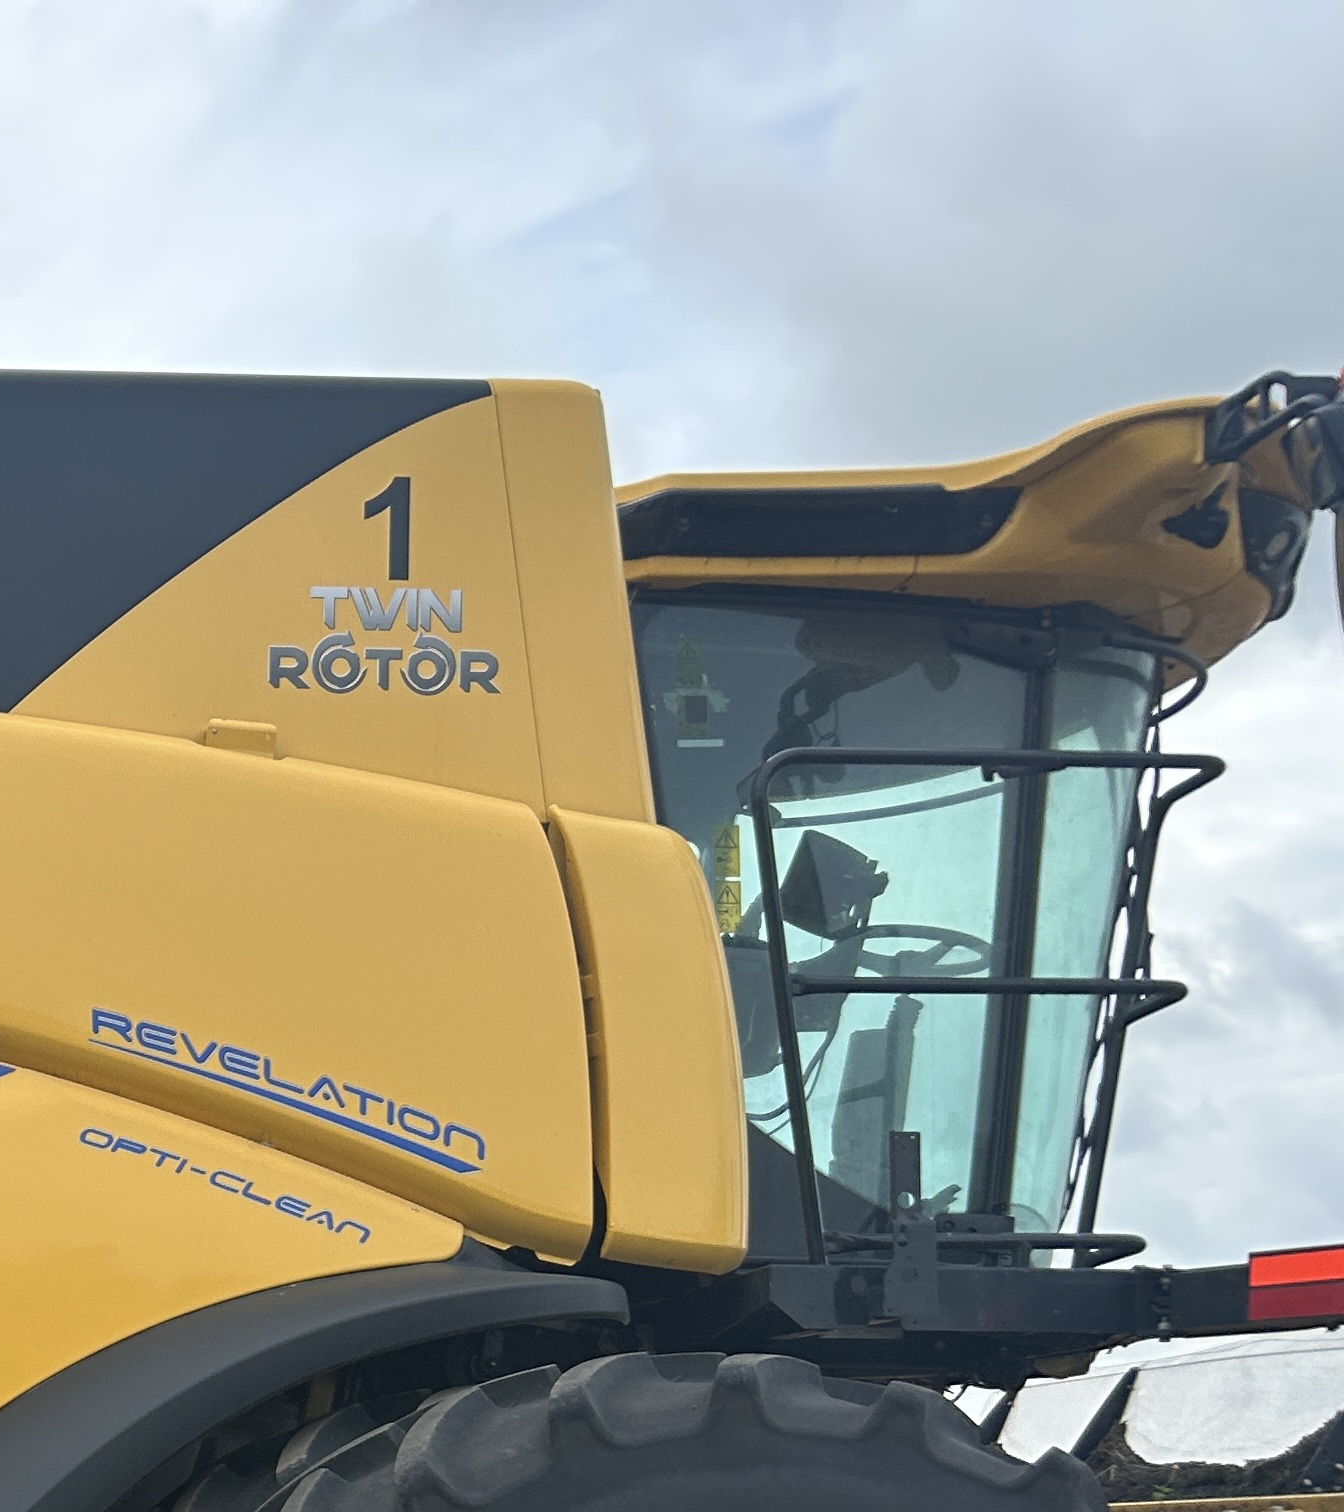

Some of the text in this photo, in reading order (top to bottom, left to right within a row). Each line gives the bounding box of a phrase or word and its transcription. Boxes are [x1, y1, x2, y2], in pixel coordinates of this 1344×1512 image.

[363, 475, 411, 581] 1
[309, 585, 463, 633] TWIN
[267, 630, 502, 696] ROTOR
[91, 1006, 485, 1161] REVELATION
[79, 1127, 372, 1244] OPTI-CLEAN
